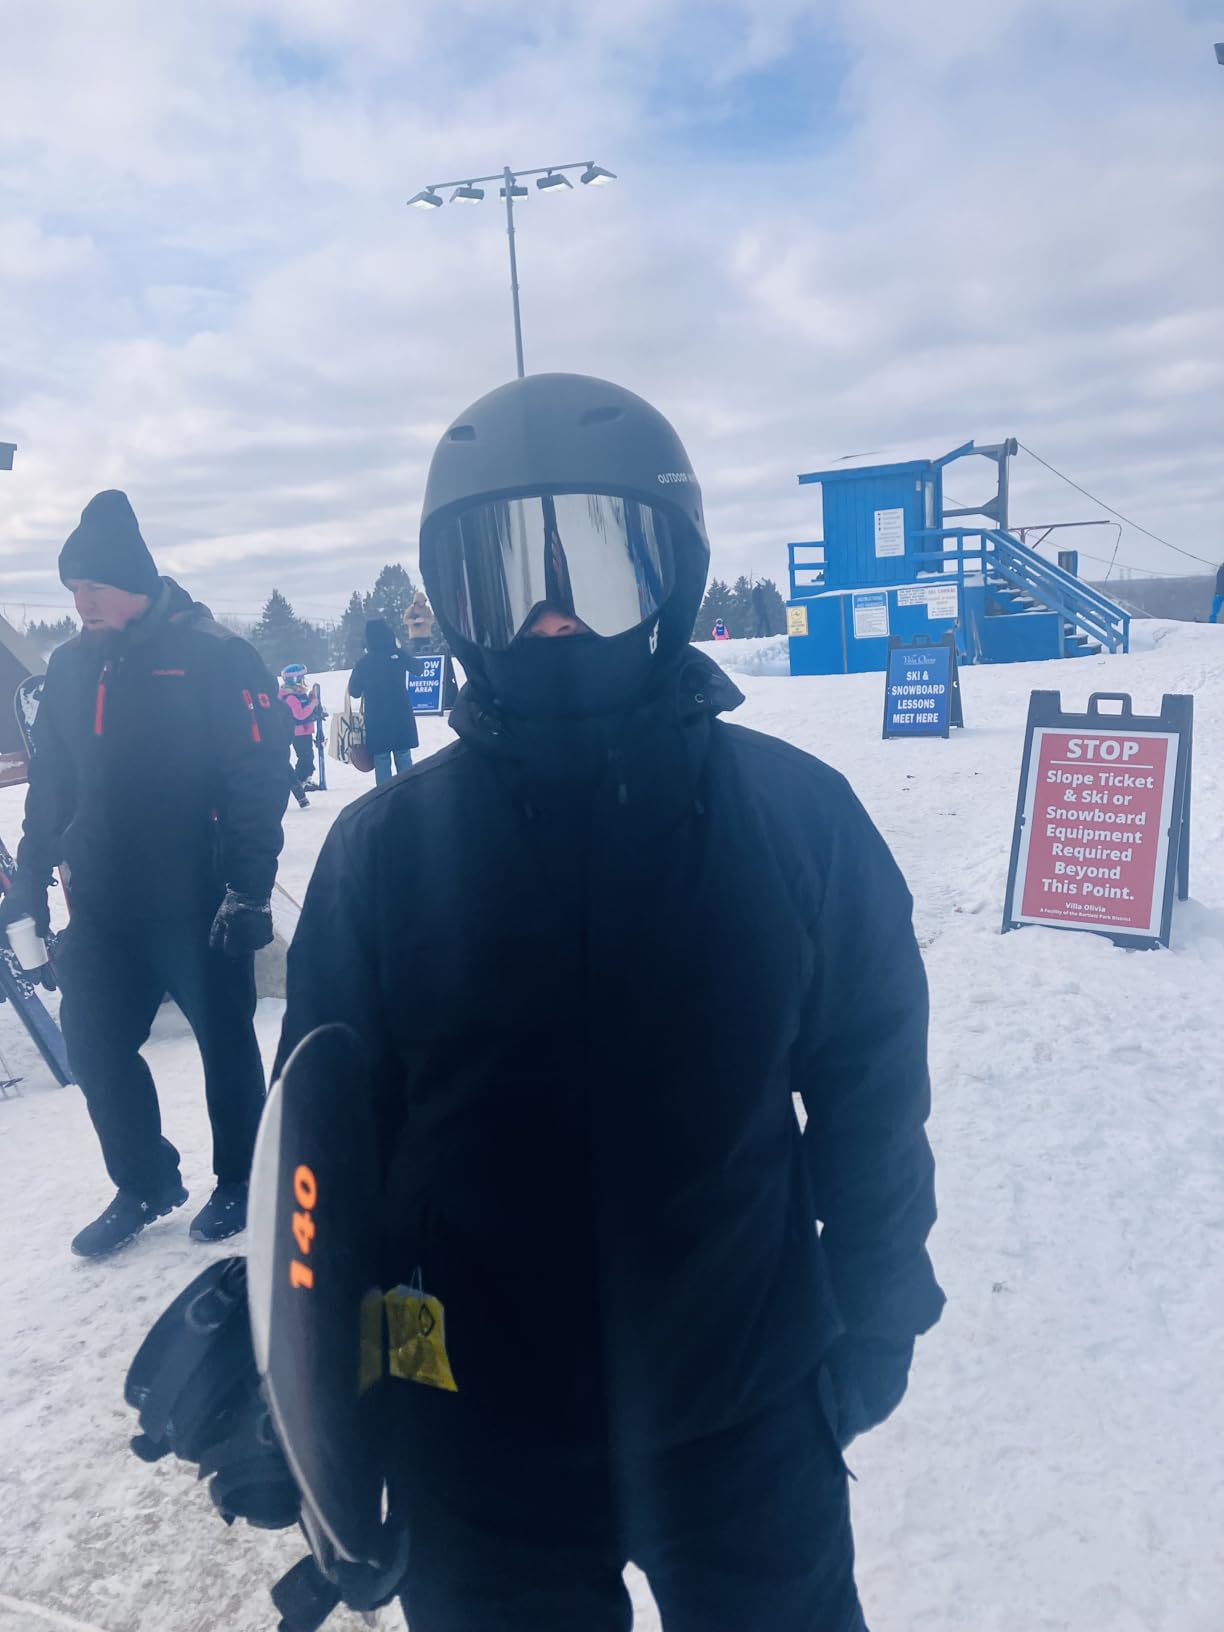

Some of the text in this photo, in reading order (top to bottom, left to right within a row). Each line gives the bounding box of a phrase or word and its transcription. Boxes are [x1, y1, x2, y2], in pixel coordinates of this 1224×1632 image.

[906, 670, 929, 681] SKI &
[891, 684, 945, 695] SNOWBOARD
[897, 699, 935, 709] LESSONS
[892, 713, 939, 724] MEET HERE
[1066, 738, 1140, 761] STOP
[1046, 770, 1154, 789] Slope Ticket
[1063, 789, 1132, 805] & Ski or
[1046, 806, 1146, 825] Snowboard
[1046, 824, 1142, 844] Equipment
[1052, 843, 1132, 862] Required
[1054, 862, 1121, 880] Beyond
[1042, 878, 1135, 900] This Point.
[1065, 902, 1106, 913] Villa Olivia
[289, 1164, 317, 1289] 140
